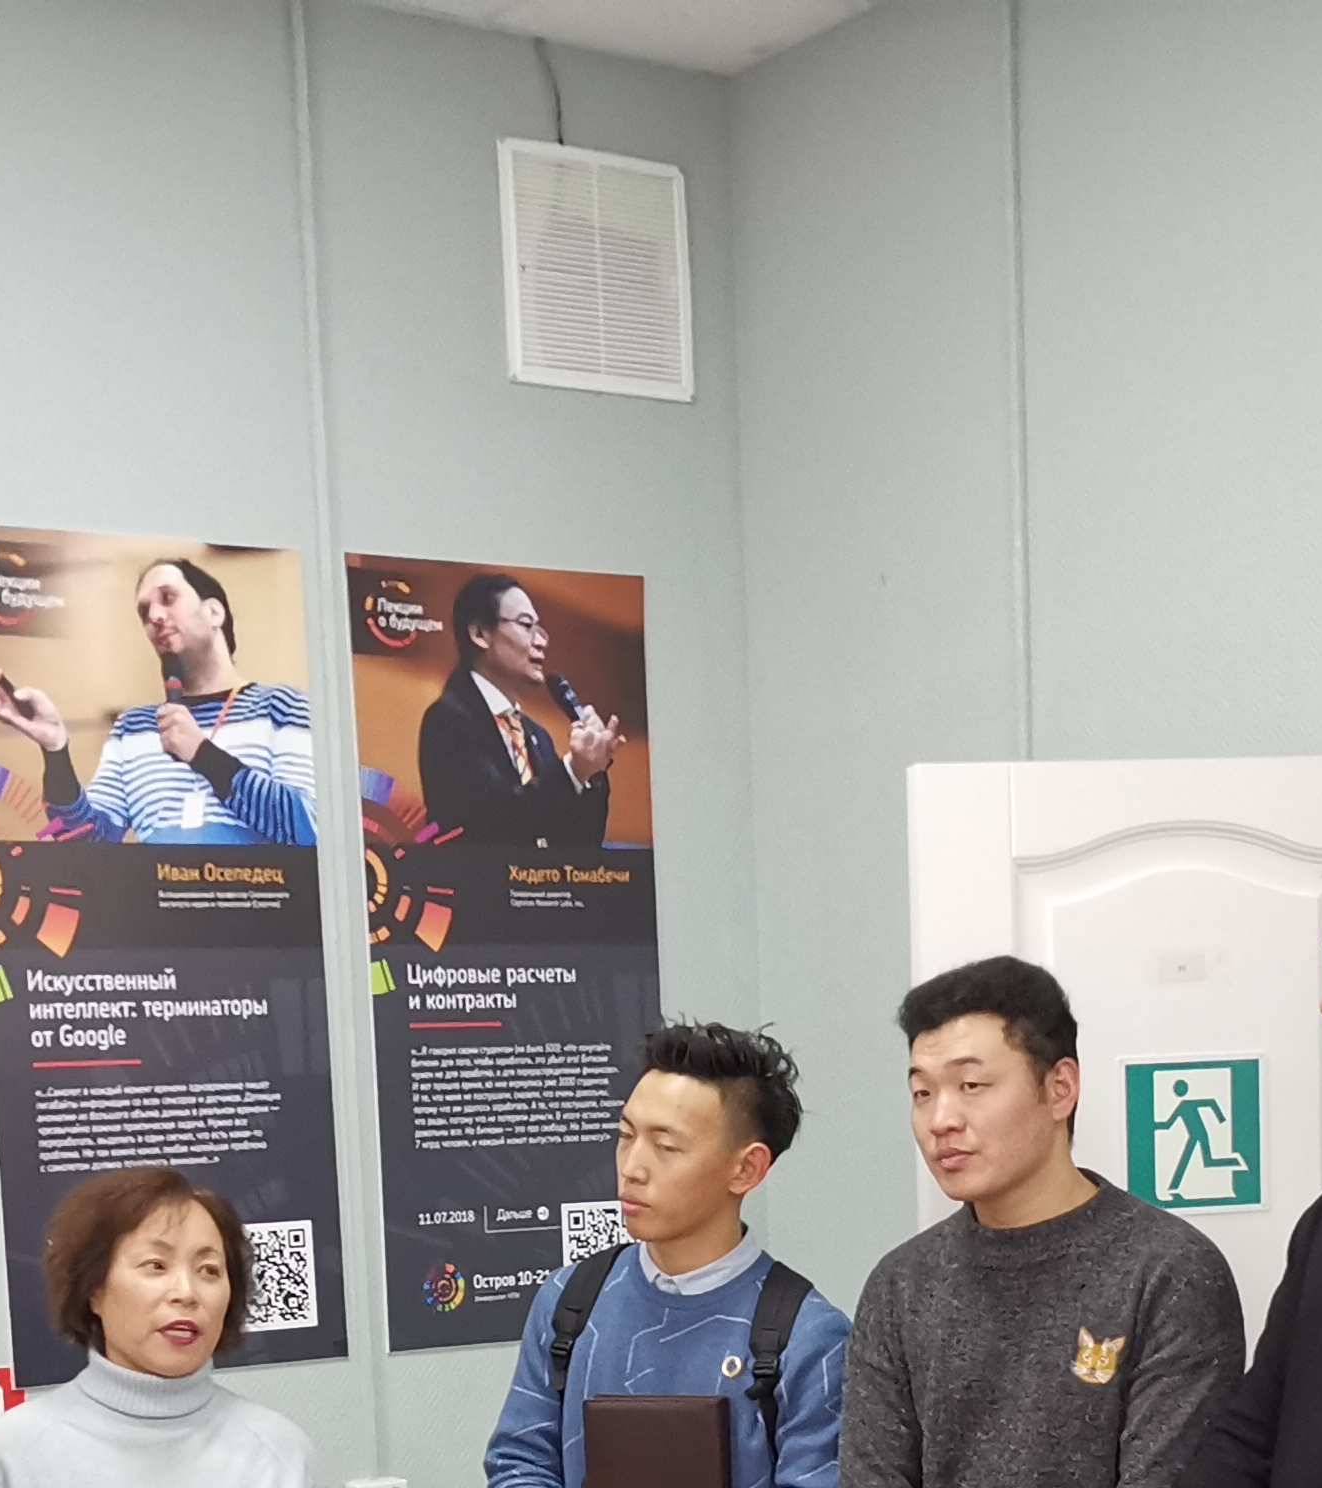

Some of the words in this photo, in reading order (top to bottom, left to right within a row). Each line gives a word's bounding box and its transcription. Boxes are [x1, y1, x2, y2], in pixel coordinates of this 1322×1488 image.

[156, 862, 201, 882] Иван
[508, 864, 561, 885] Хидето
[26, 967, 177, 997] Искусственный
[406, 962, 502, 989] Цифровые
[505, 967, 577, 988] расчеты
[29, 1001, 138, 1020] интеллект:
[141, 998, 269, 1022] терминаторы
[408, 994, 421, 1010] и
[425, 992, 518, 1014] контракты
[30, 1029, 54, 1048] от
[58, 1023, 127, 1051] Google
[417, 1209, 476, 1226] 11.07.2018
[472, 1272, 516, 1291] Остров
